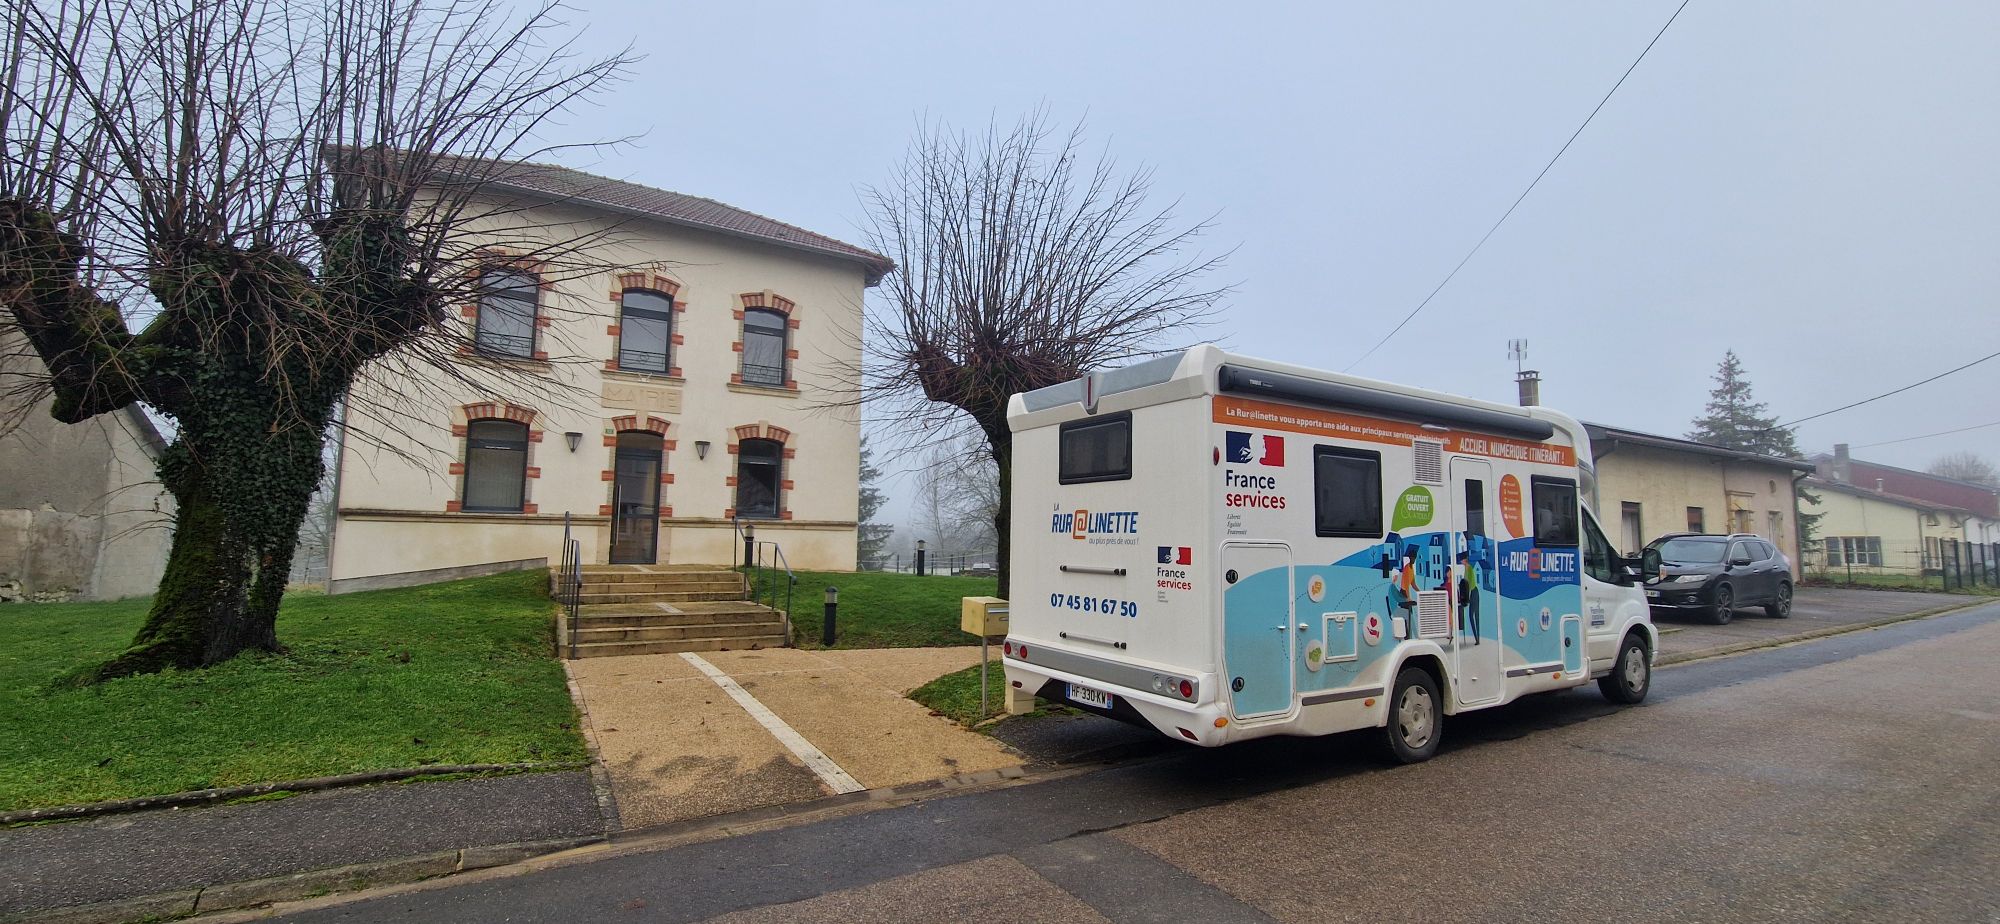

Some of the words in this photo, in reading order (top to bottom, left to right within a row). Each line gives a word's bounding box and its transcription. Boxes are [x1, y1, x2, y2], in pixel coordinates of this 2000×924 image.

[1226, 406, 1236, 416] La
[1236, 408, 1279, 422] Rur@linette
[1279, 415, 1296, 424] vous
[1296, 419, 1322, 429] apporte
[1323, 422, 1335, 430] une
[1336, 422, 1350, 432] aide
[1350, 425, 1361, 433] aux
[1362, 427, 1393, 438] principaux
[1393, 430, 1414, 440] services
[1459, 437, 1489, 455] ACCUEIL
[1490, 439, 1528, 461] NUMÉRIQUE
[1529, 444, 1561, 464] ITINÉRANT
[1561, 451, 1565, 465] !
[1226, 469, 1276, 490] France
[1226, 490, 1286, 509] services
[1406, 494, 1430, 503] GRATUIT
[1053, 503, 1060, 511] LA
[1408, 503, 1430, 512] OUVERT
[1051, 509, 1139, 540] RUR@LINETTE
[1095, 536, 1106, 546] plus
[1501, 555, 1509, 567] LA
[1157, 566, 1186, 579] France
[1157, 578, 1192, 591] services
[1050, 593, 1064, 608] 07
[1066, 594, 1081, 610] 45
[1083, 596, 1097, 612] 81
[1101, 598, 1117, 615] 67
[1120, 600, 1138, 618] 50
